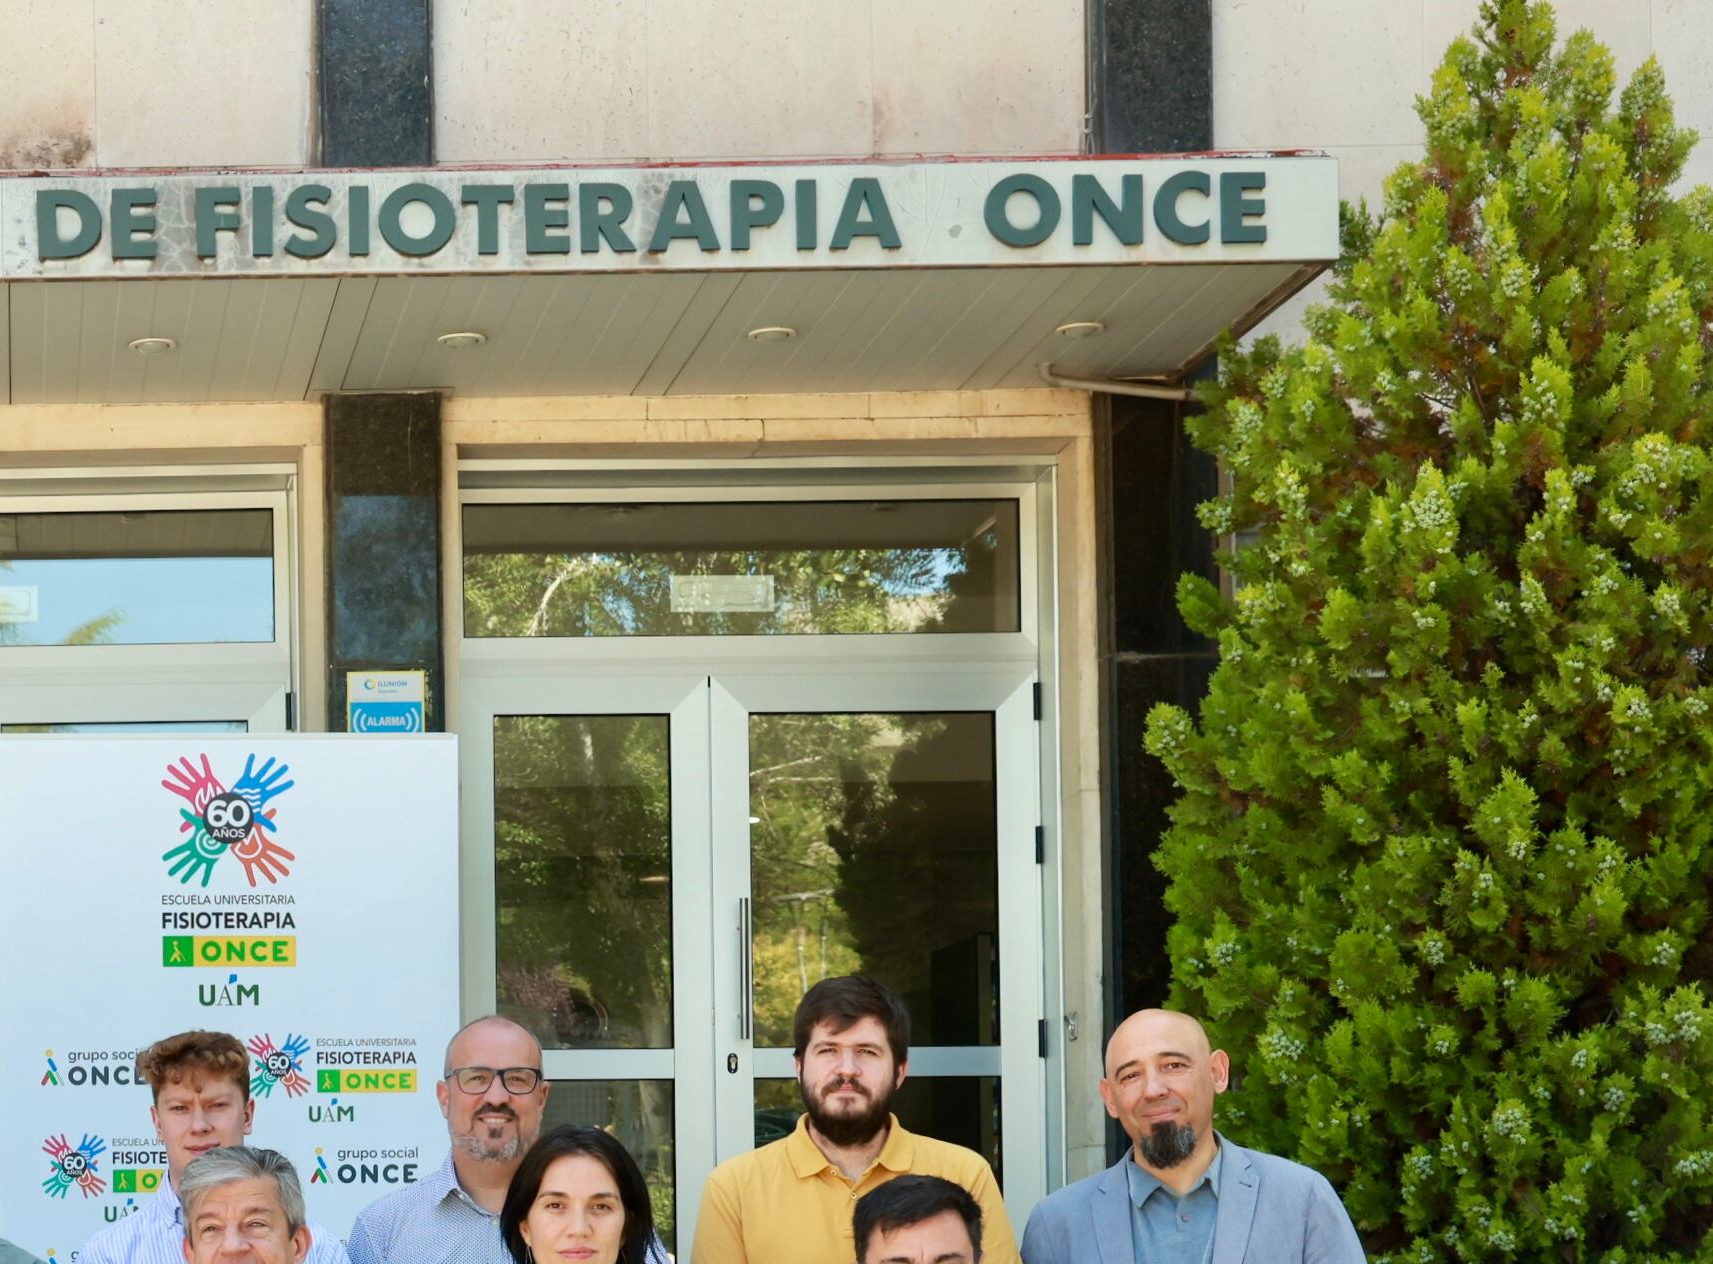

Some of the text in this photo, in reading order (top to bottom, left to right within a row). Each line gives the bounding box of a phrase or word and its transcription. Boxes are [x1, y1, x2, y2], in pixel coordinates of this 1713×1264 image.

[37, 187, 157, 259] DE
[195, 177, 902, 258] FISIOTERAPIA
[984, 171, 1267, 248] ONCE
[377, 680, 408, 688] ILUNION
[367, 715, 406, 727] ALARMA
[206, 799, 250, 828] 60
[212, 827, 245, 838] AÑOS
[161, 894, 296, 905] ESCUELA UNIVERSITARIA
[162, 911, 296, 929] FISIOTERAPIA
[201, 940, 289, 962] ONCE
[198, 982, 260, 1007] UAM
[316, 1038, 417, 1047] ESCUELA UNIVERSITARIA
[68, 1051, 109, 1064] grupo
[268, 1055, 290, 1069] 60
[316, 1051, 417, 1065] FISIOTERAPIA
[345, 1072, 412, 1089] ONCE
[308, 1104, 355, 1123] UAM
[111, 1137, 150, 1147] ESCUELA
[337, 1146, 419, 1161] grupo social
[63, 1156, 86, 1170] 60
[337, 1163, 418, 1184] ONCE
